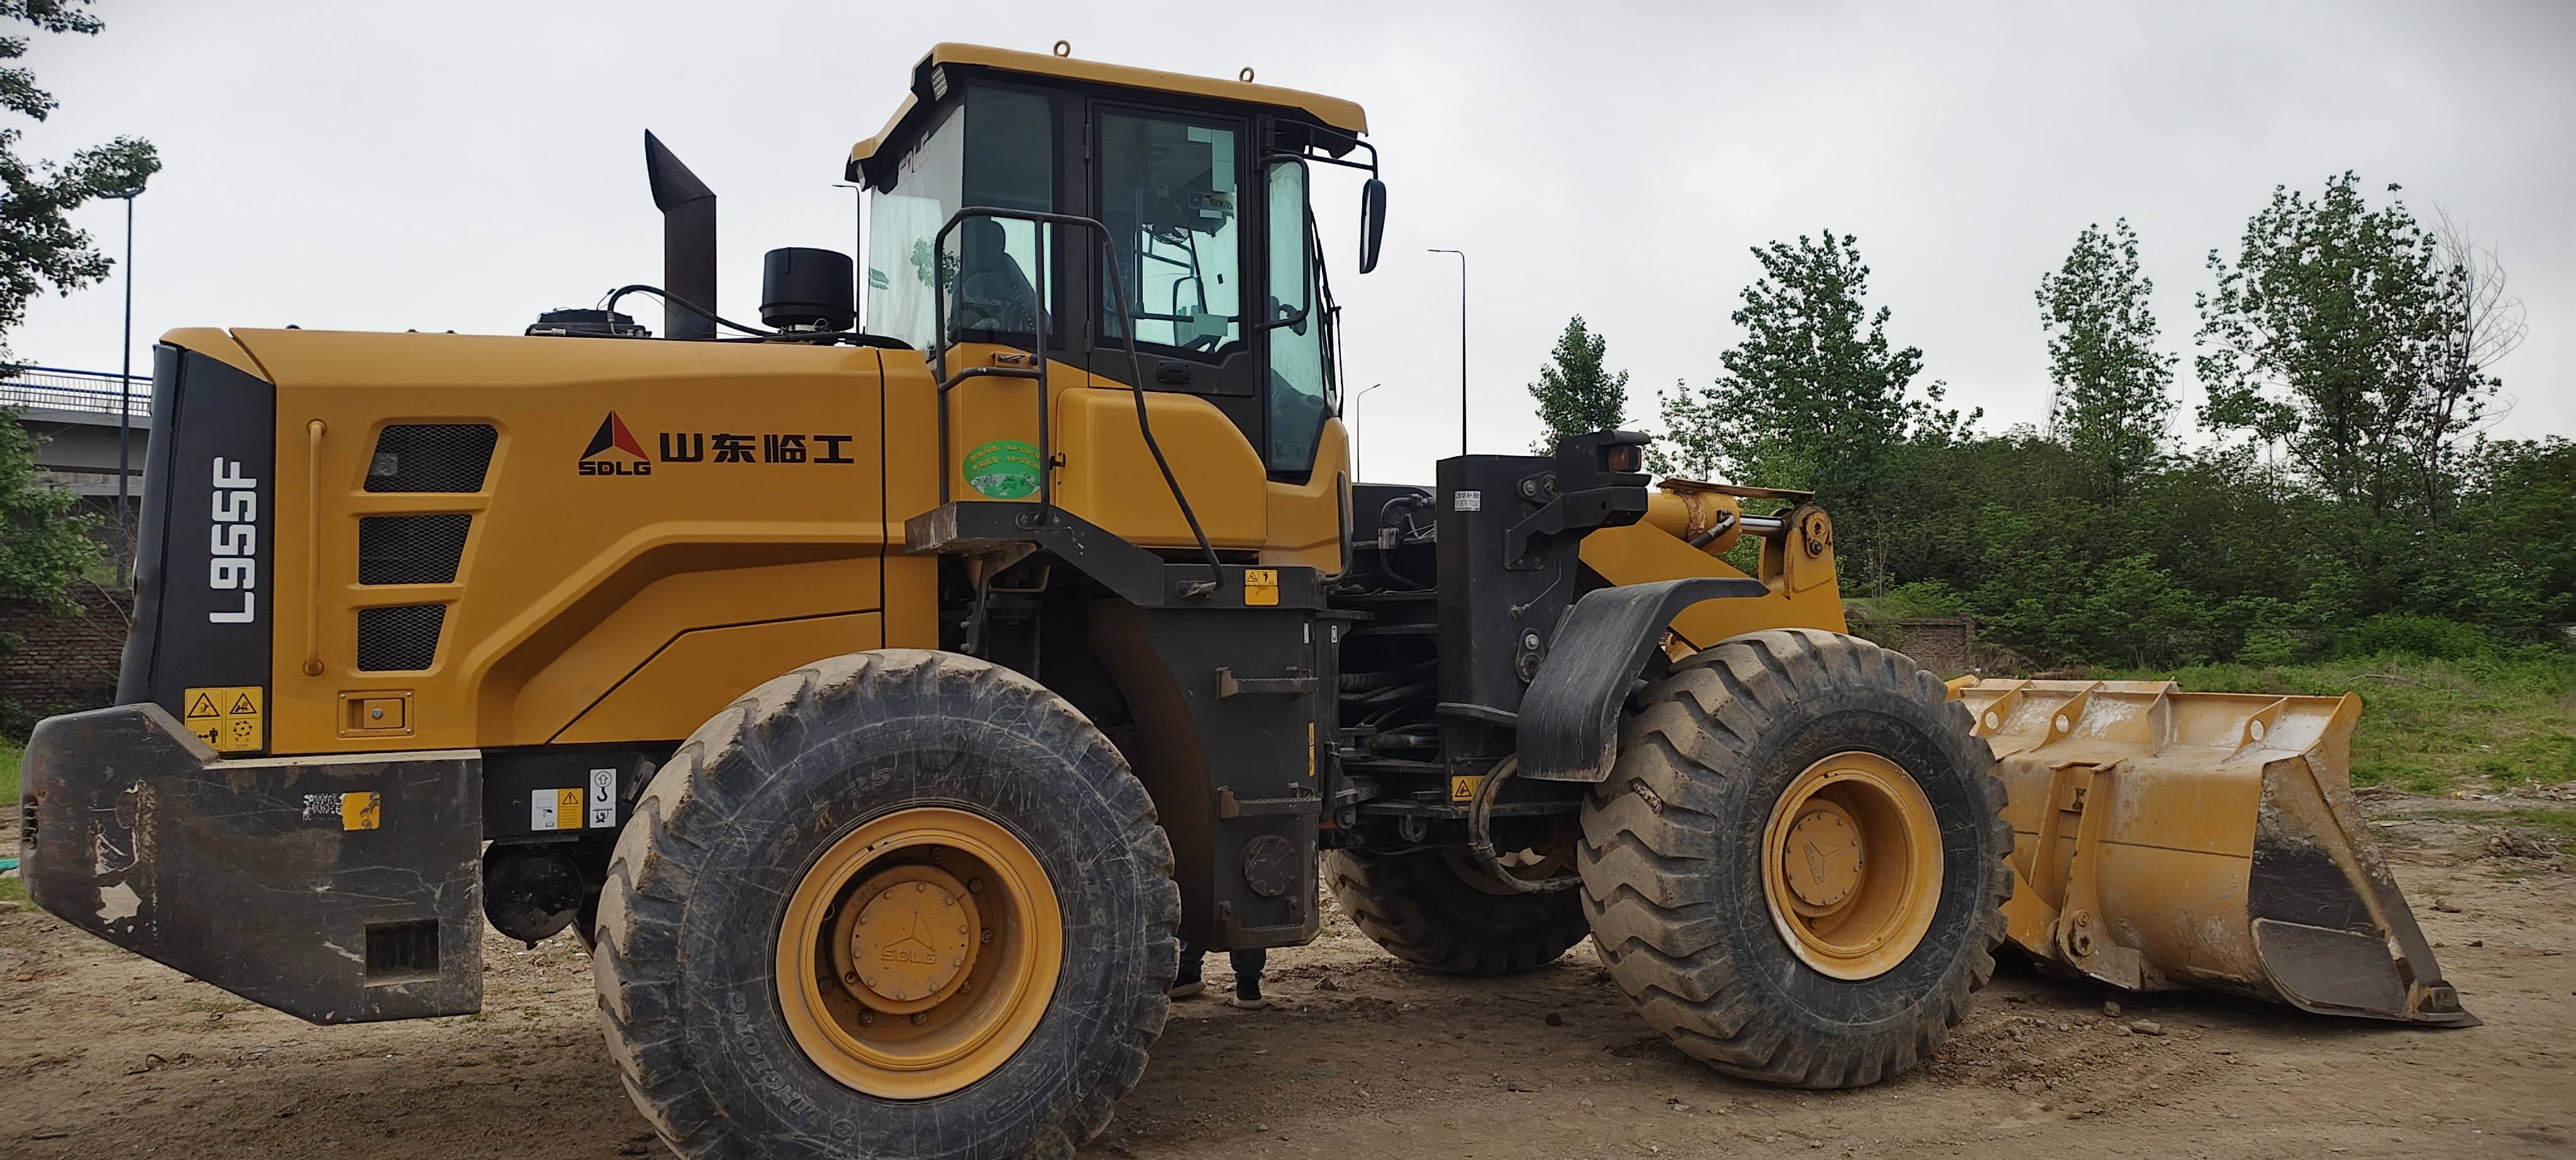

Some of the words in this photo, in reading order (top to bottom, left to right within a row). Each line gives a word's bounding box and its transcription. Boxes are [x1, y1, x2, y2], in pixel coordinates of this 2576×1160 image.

[659, 433, 855, 464] 山东临工
[579, 461, 651, 476] SDLG
[209, 457, 257, 623] L955F
[881, 950, 936, 965] SDLG
